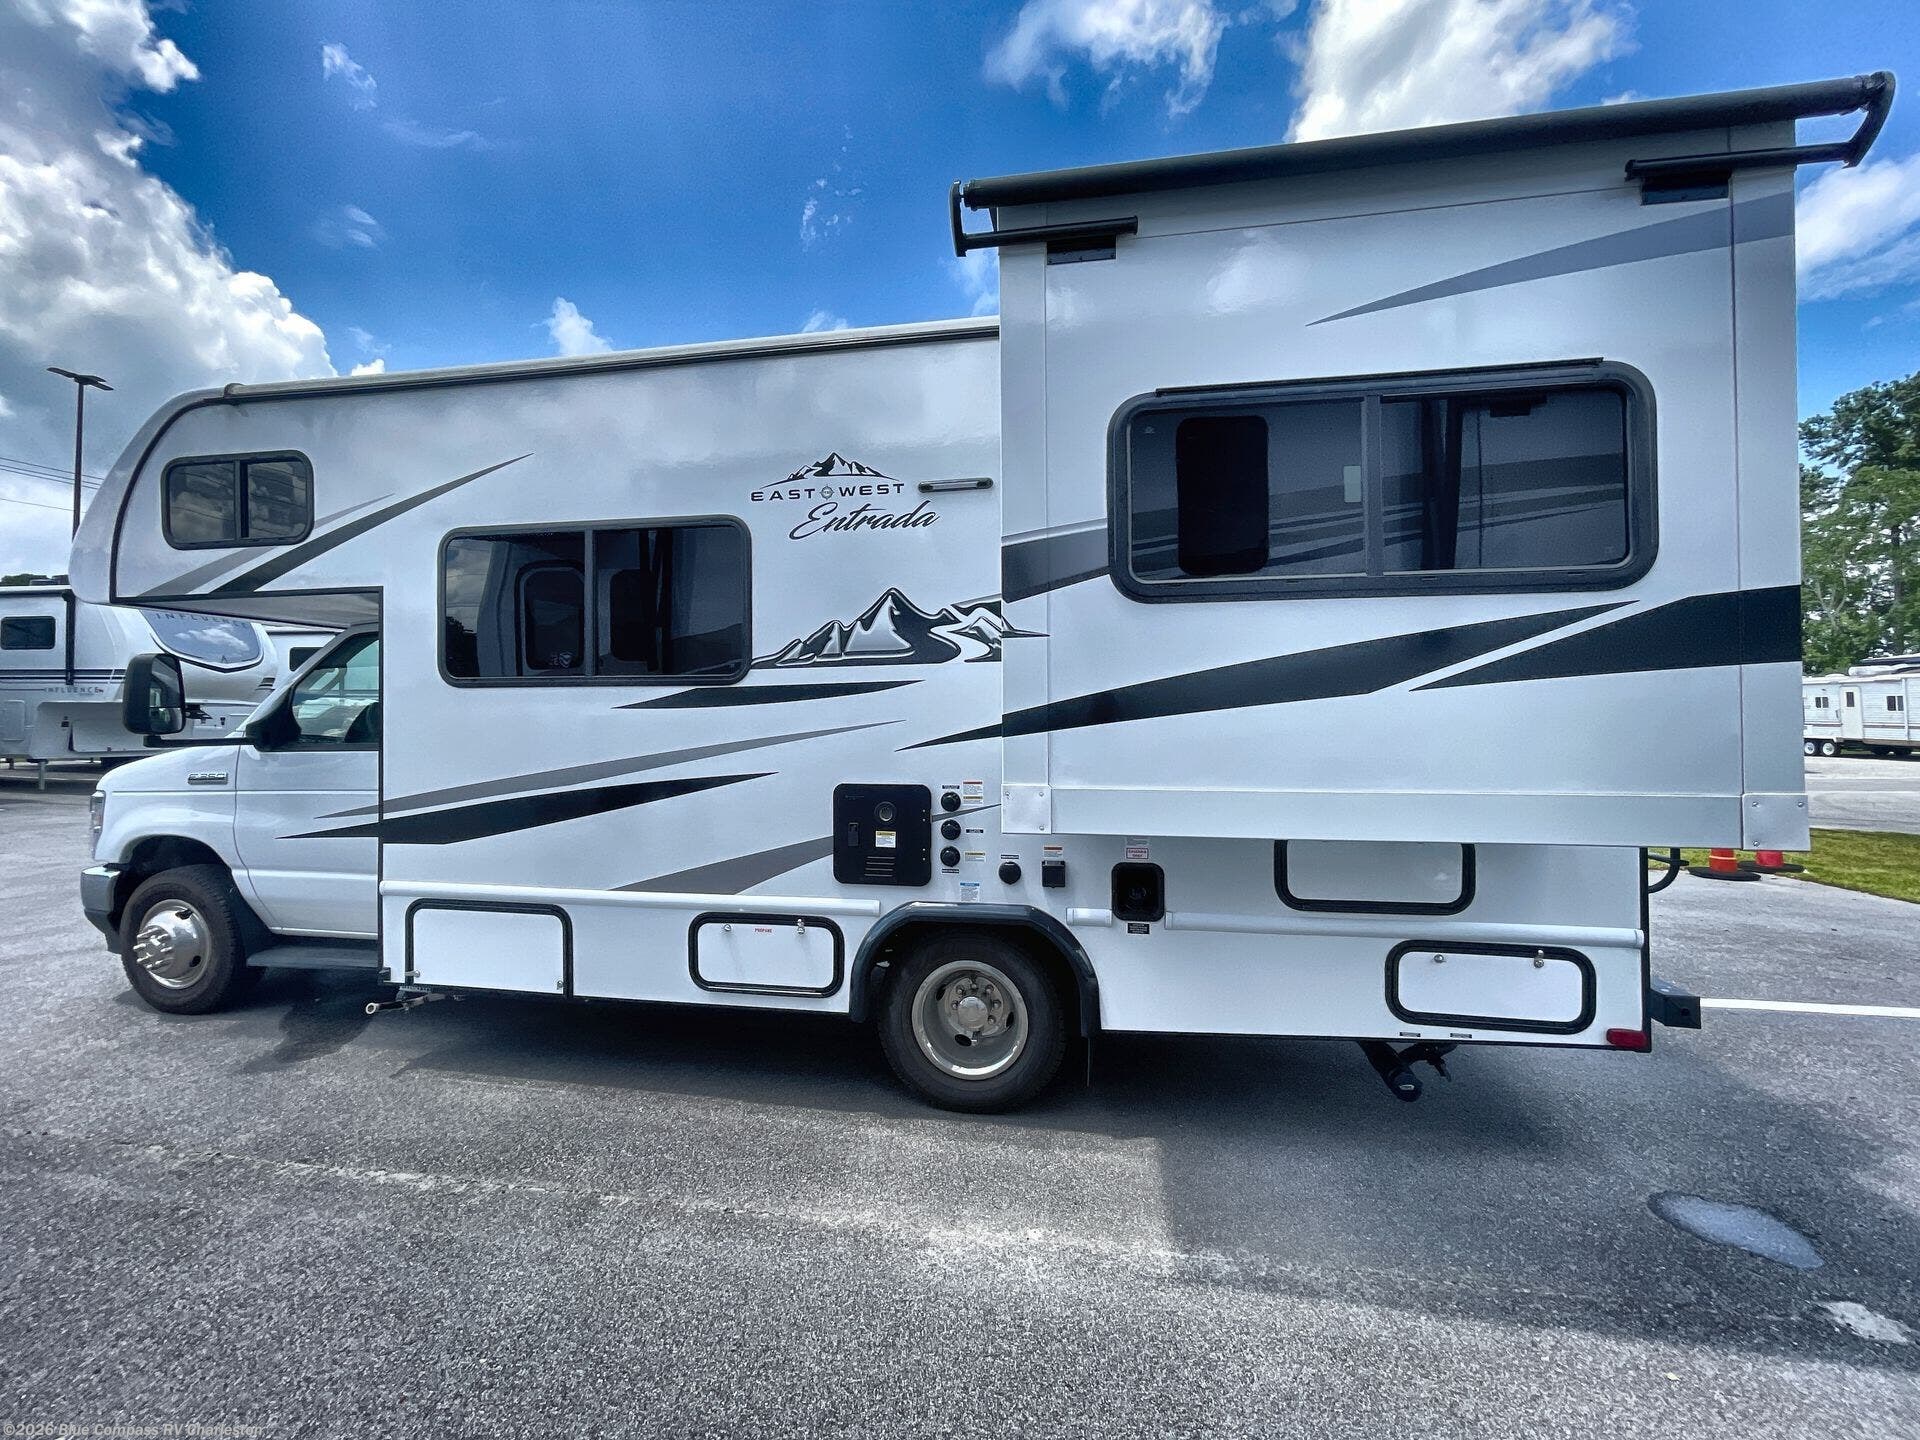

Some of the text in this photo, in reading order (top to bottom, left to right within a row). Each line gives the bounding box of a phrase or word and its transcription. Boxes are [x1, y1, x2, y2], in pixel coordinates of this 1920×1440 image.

[750, 488, 815, 502] EAST
[839, 482, 905, 497] WEST
[788, 500, 941, 541] Entrada
